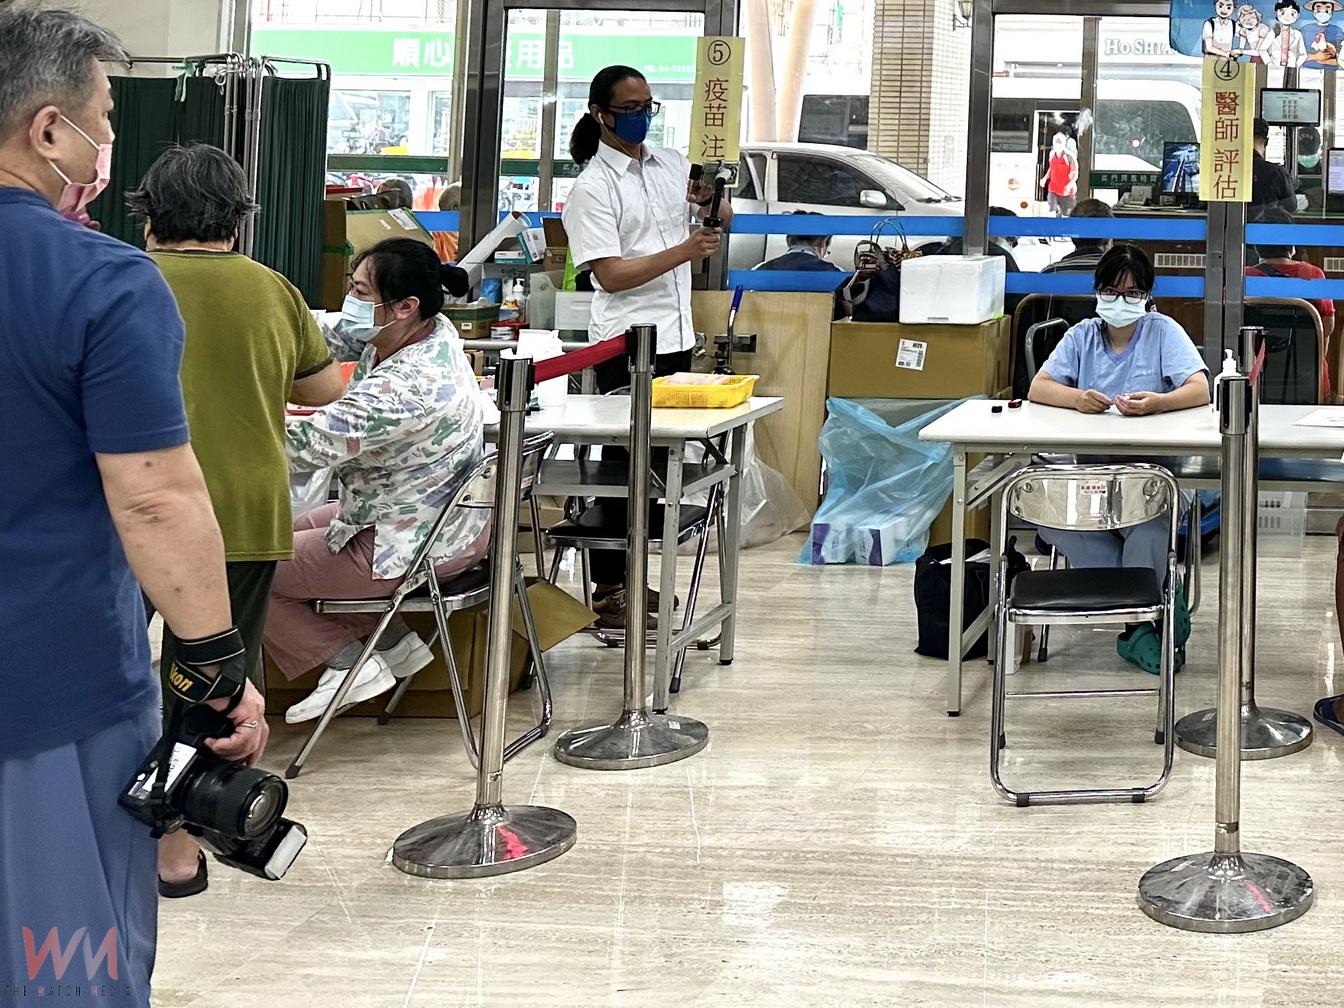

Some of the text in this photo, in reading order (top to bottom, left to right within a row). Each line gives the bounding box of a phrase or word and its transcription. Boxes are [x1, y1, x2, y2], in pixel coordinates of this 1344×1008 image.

[701, 77, 729, 160] 疫苗注
[1213, 91, 1240, 200] 醫師評估
